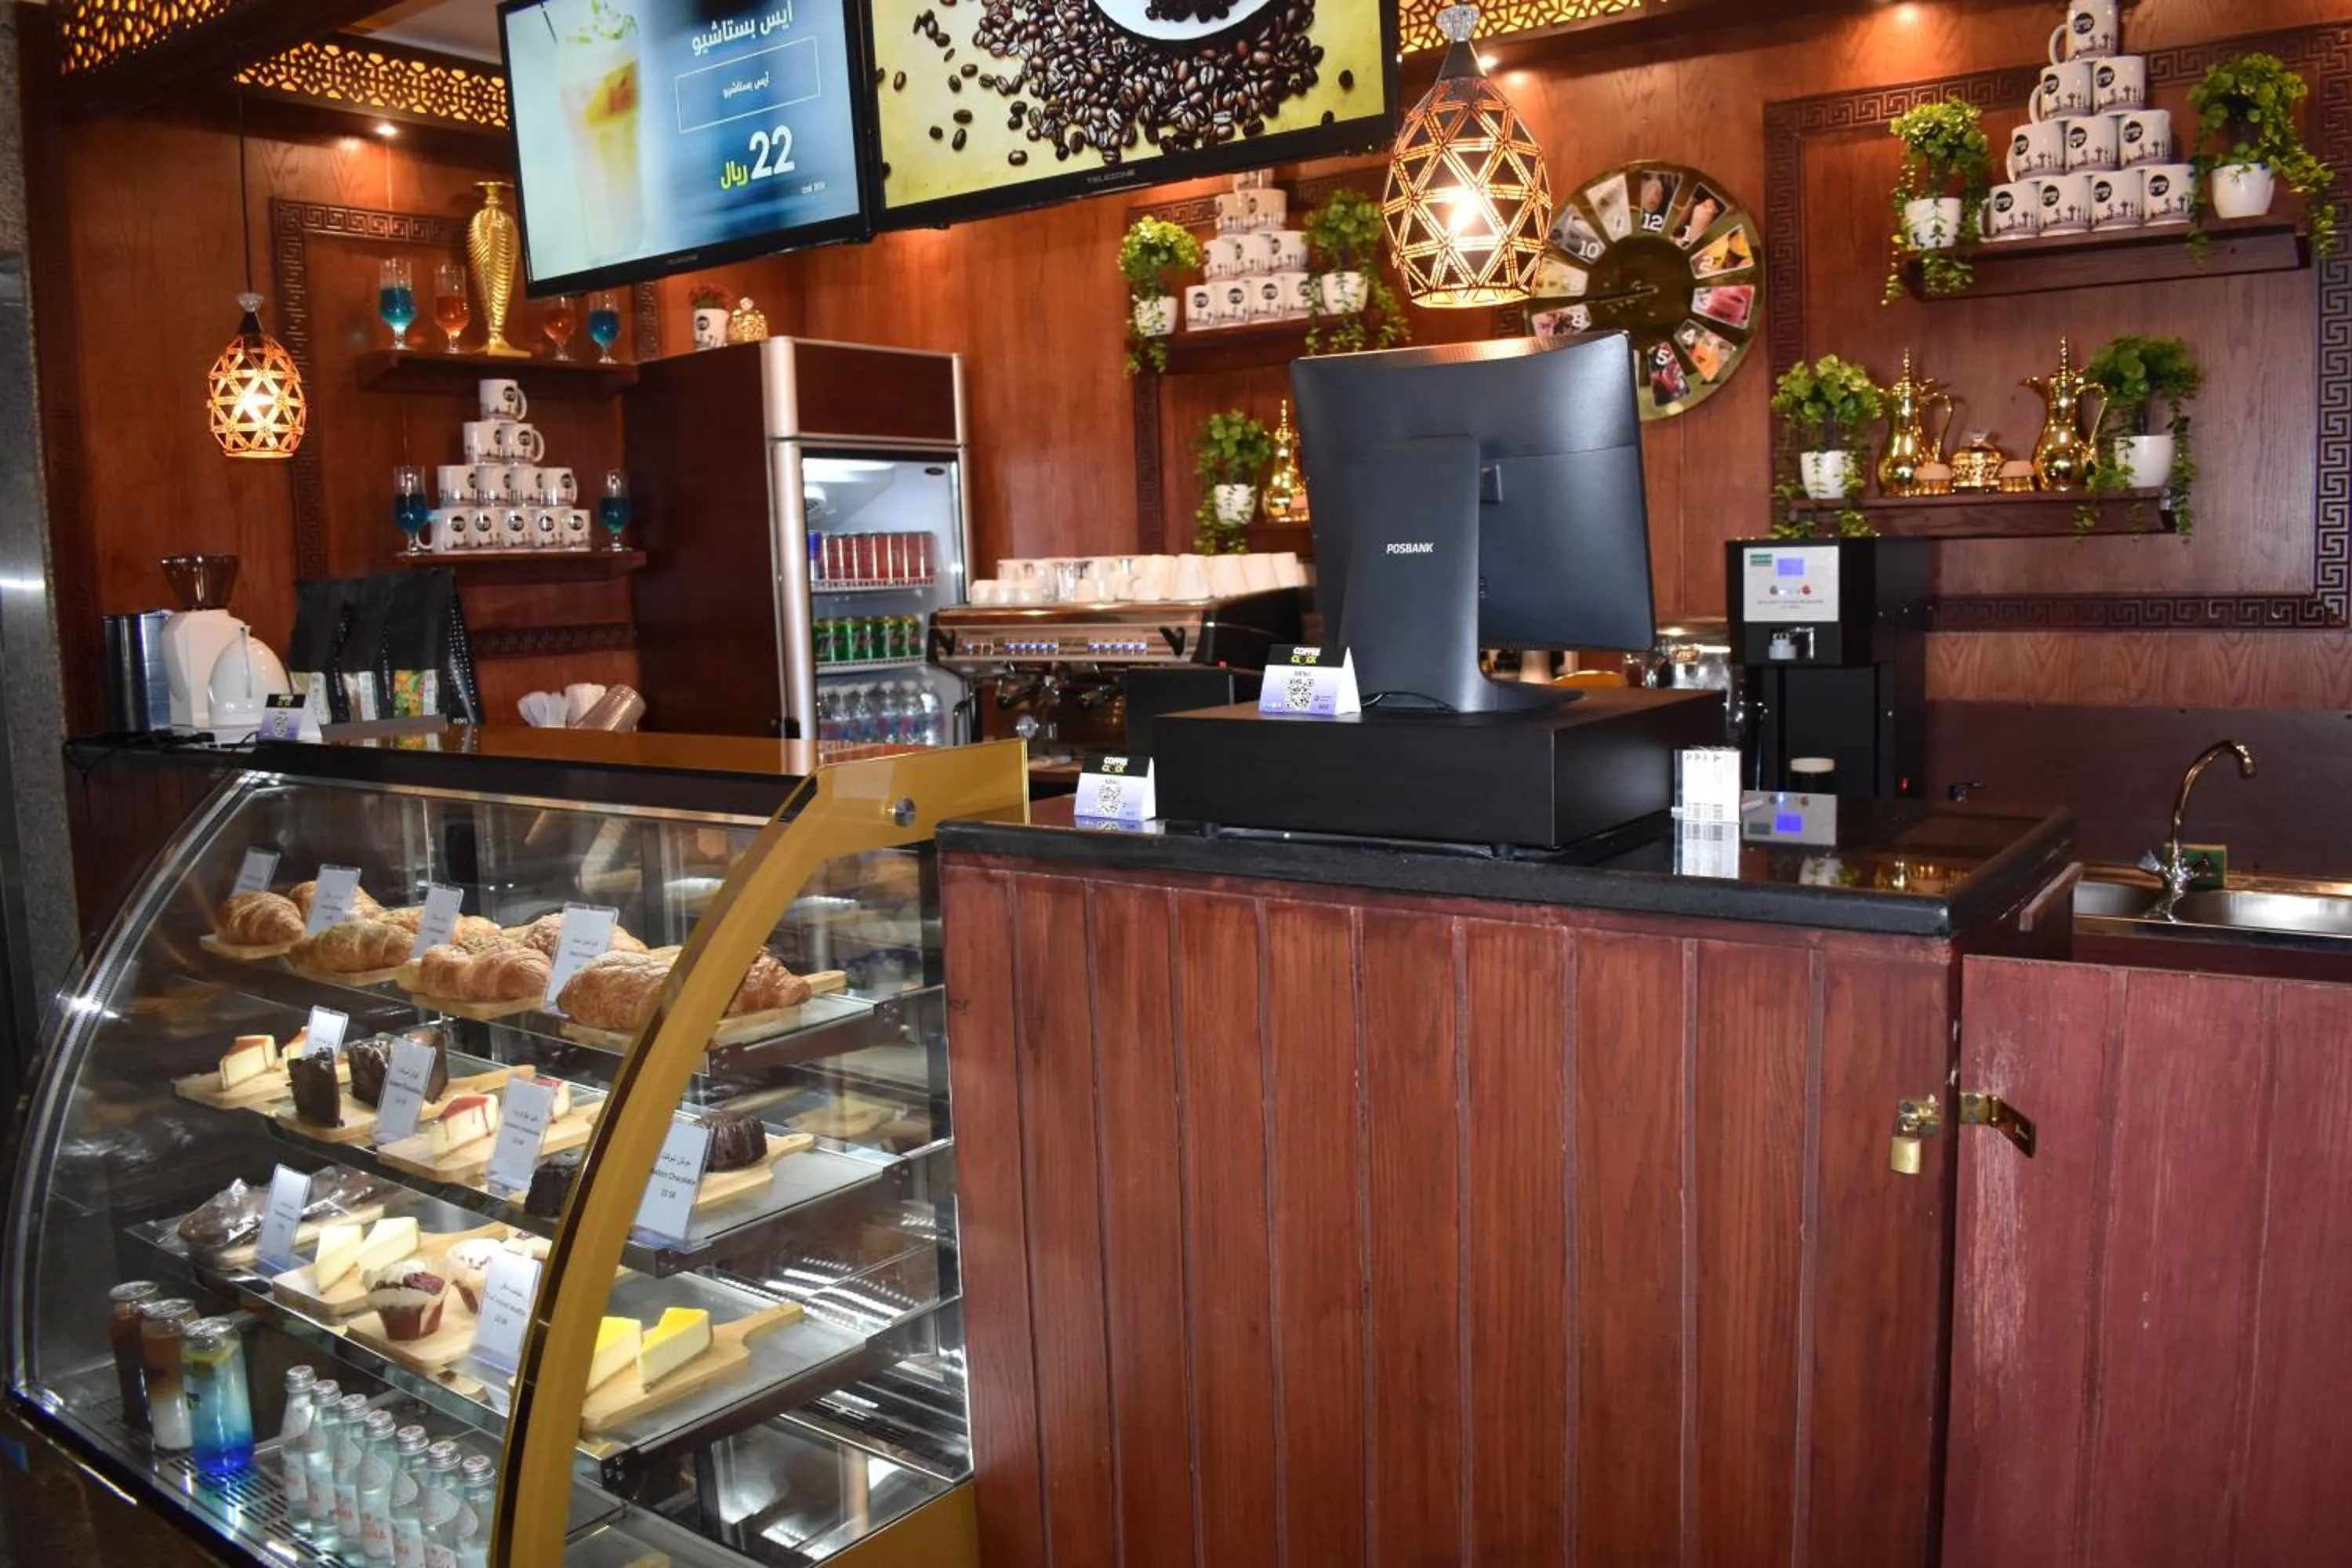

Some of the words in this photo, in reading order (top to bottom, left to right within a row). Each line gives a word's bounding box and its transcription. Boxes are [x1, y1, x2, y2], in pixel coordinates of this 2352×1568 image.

[692, 20, 756, 56] بستاشيو
[749, 125, 796, 180] 22
[720, 160, 749, 190] ريال
[1641, 212, 1664, 233] 12
[1578, 240, 1600, 259] 10
[1681, 328, 1696, 345] 4
[1655, 348, 1670, 366] 5
[1385, 542, 1434, 554] POSBANK
